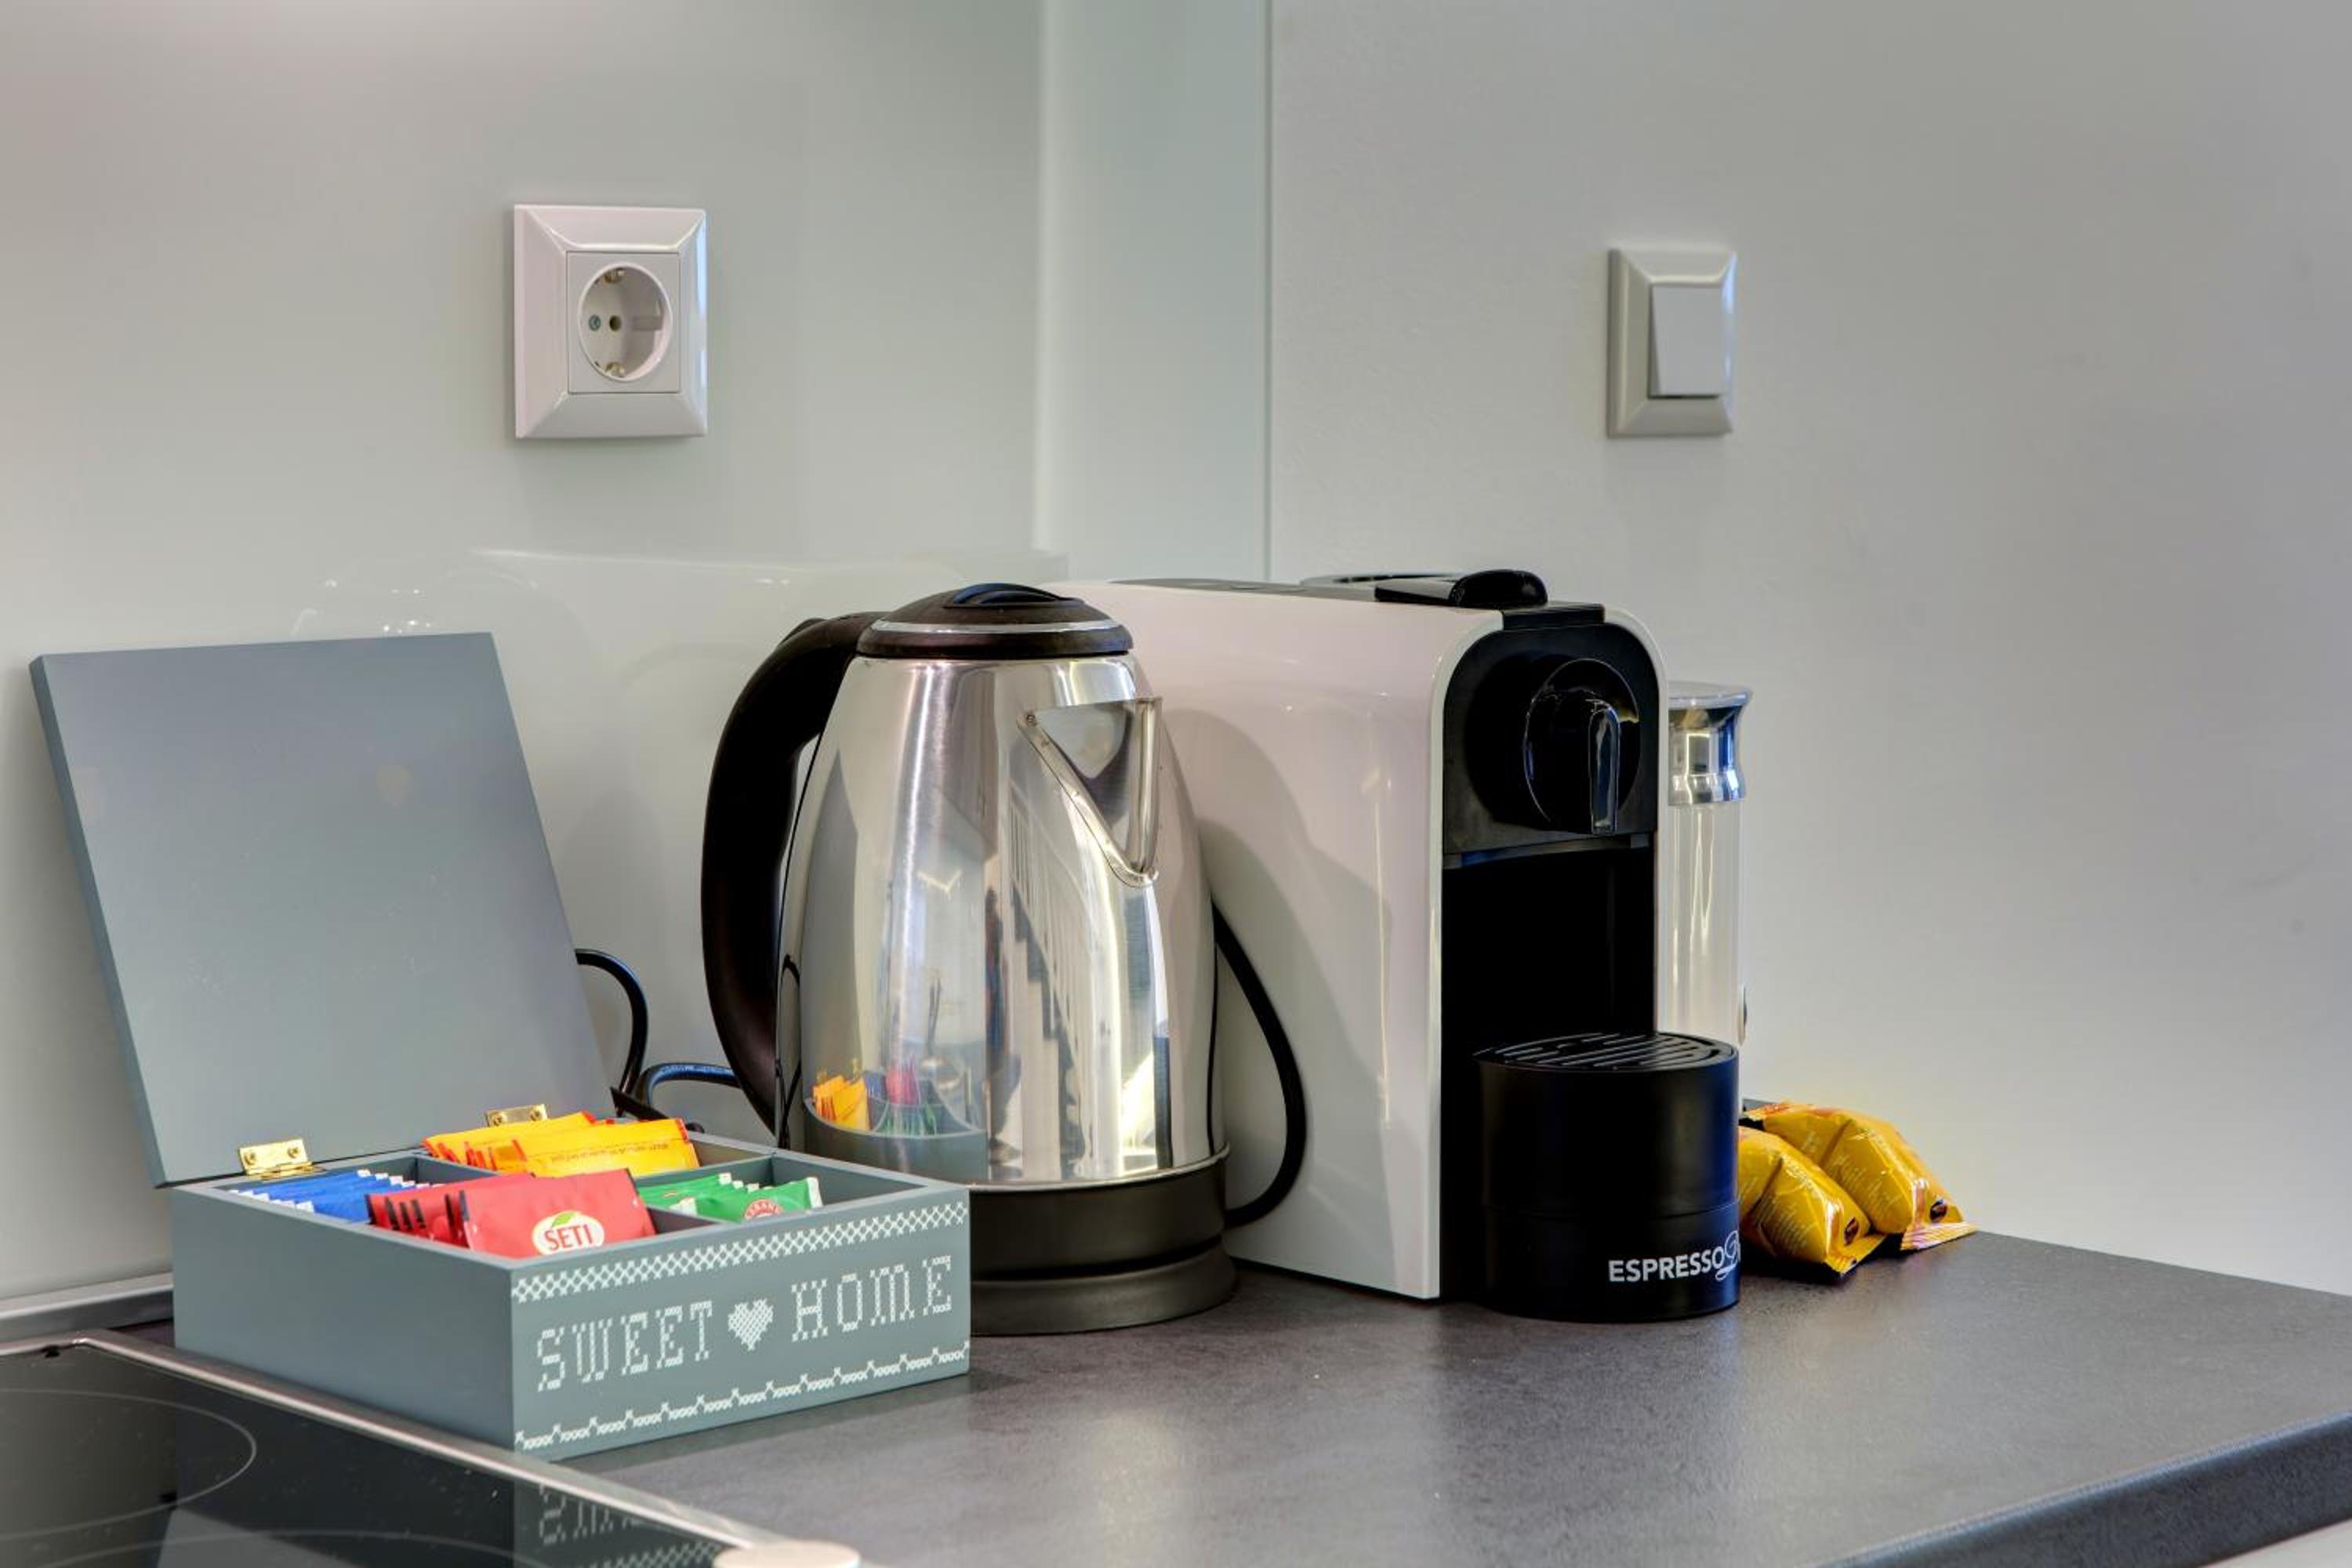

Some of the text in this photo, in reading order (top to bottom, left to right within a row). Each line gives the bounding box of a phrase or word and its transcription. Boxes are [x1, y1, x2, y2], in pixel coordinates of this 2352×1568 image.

[543, 1224, 593, 1251] SETI
[537, 1255, 952, 1392] SWEET HOME
